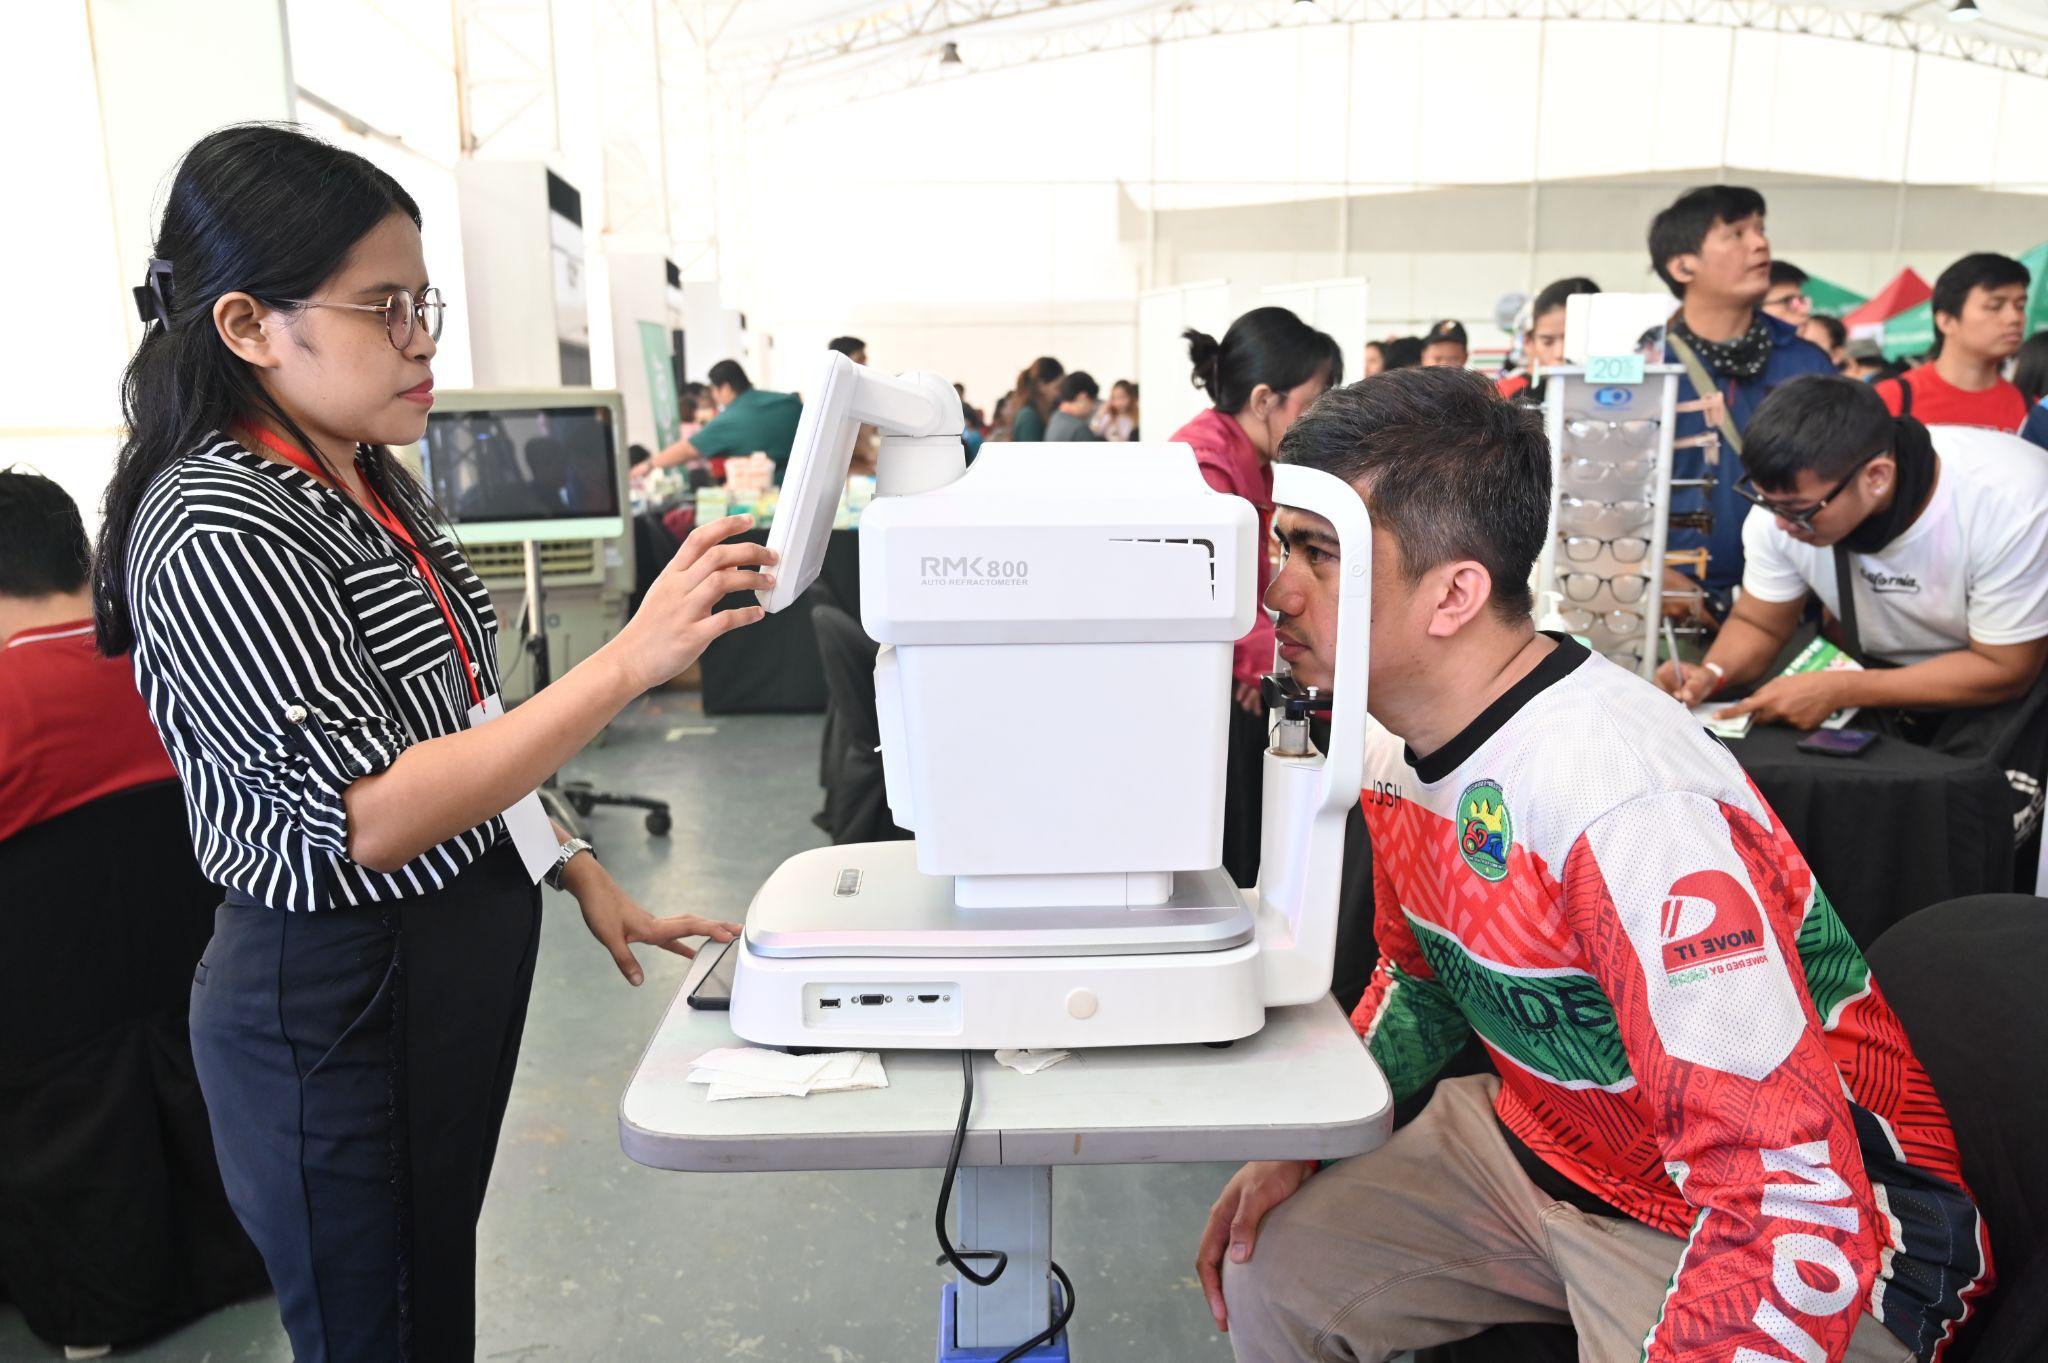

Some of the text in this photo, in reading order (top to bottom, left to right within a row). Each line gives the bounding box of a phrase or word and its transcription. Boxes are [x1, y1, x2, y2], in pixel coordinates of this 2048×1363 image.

[921, 556, 1028, 578] RMK 800
[1369, 779, 1402, 811] JOSH
